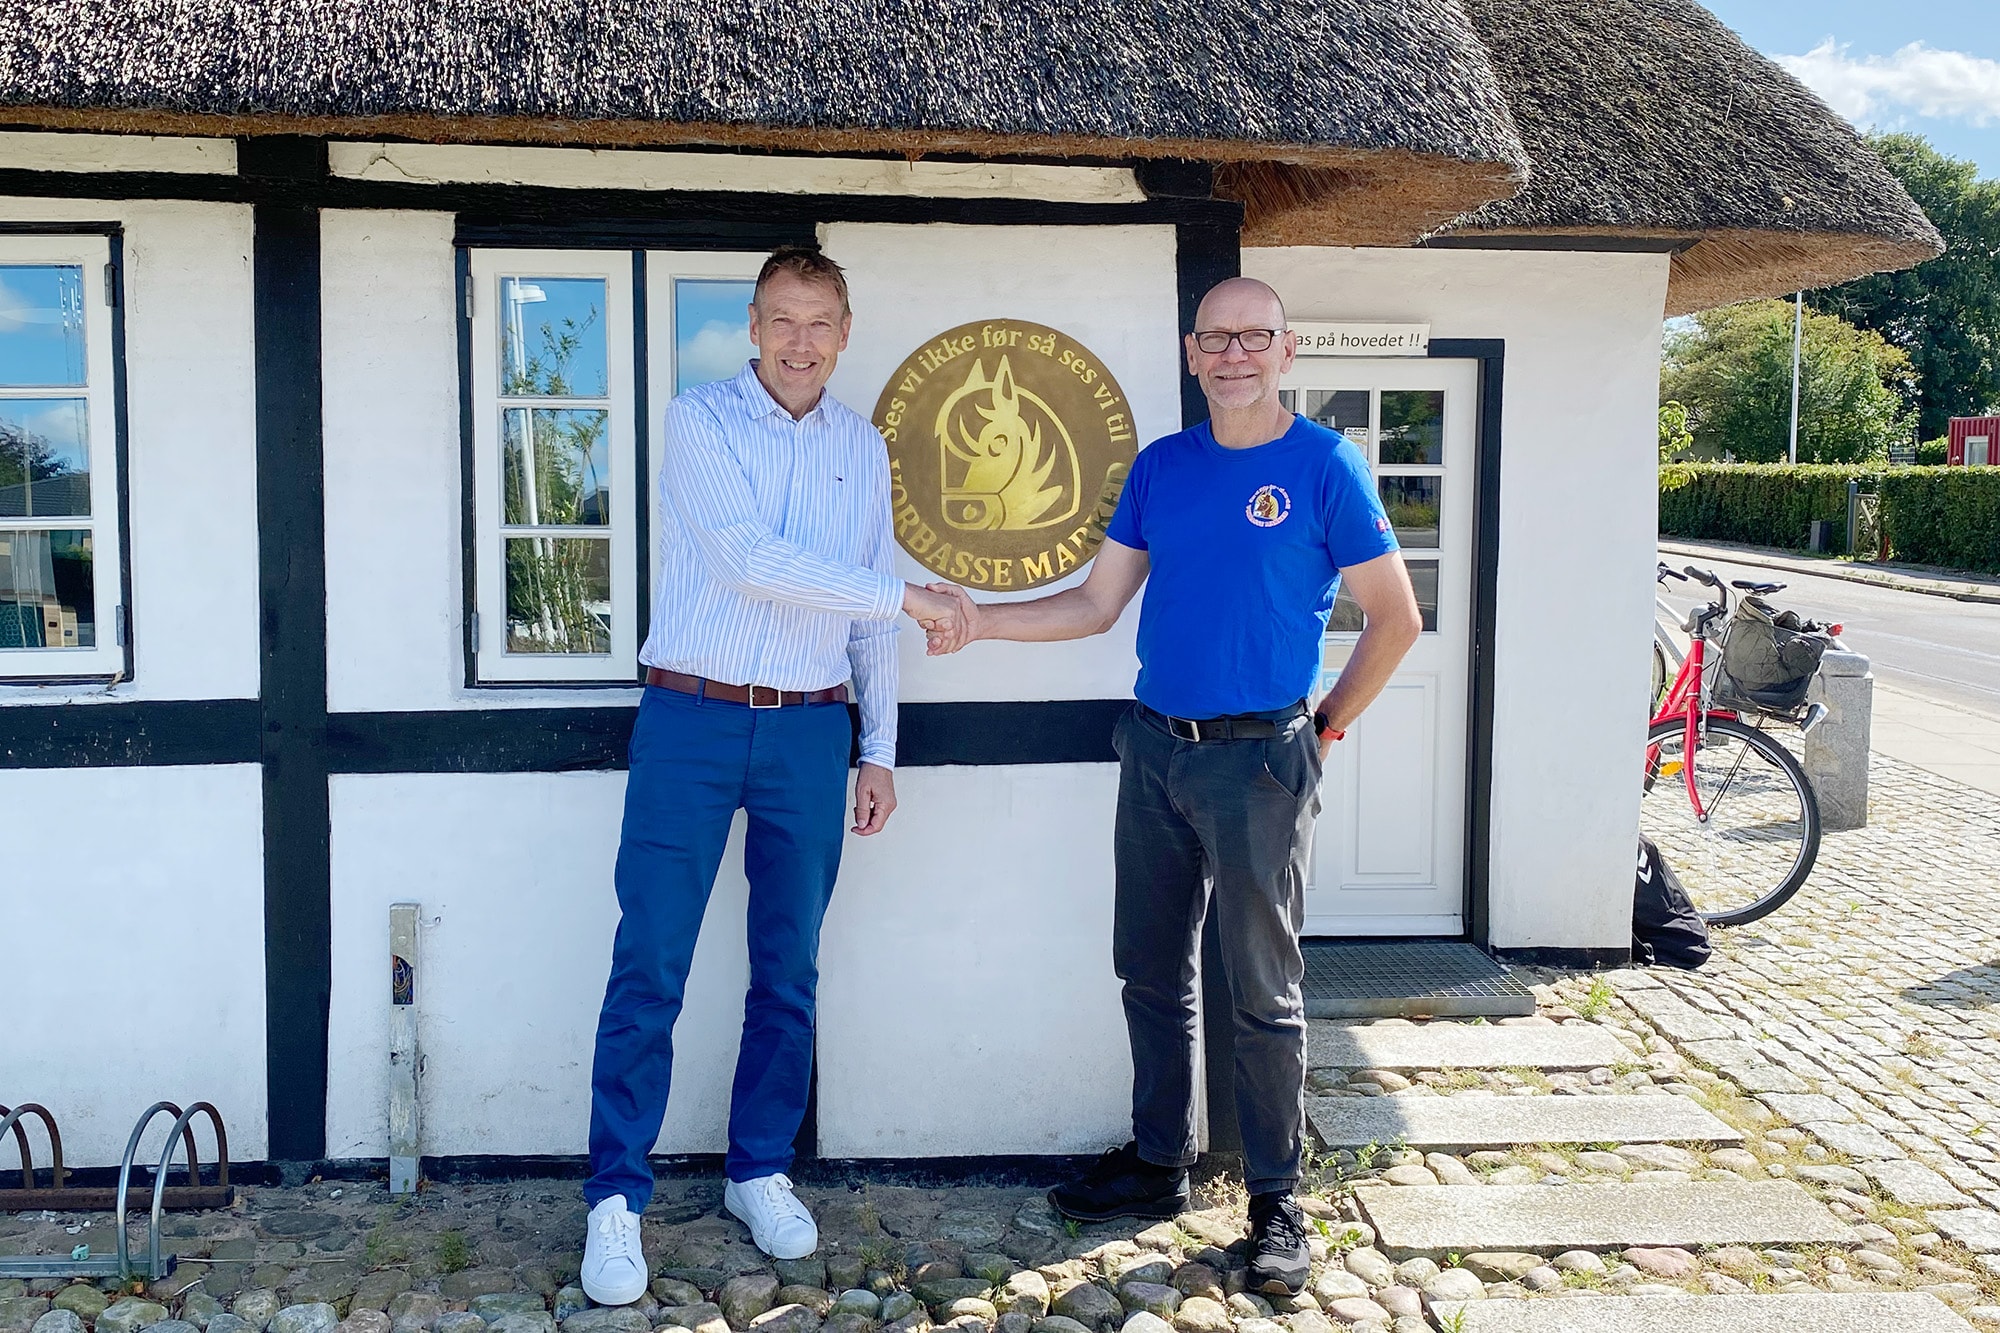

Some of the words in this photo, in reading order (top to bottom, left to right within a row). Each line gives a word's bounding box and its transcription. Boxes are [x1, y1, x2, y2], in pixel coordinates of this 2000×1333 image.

[981, 324, 1023, 348] før
[1027, 333, 1057, 357] så
[1296, 334, 1311, 346] as
[1316, 332, 1335, 349] på
[1340, 332, 1404, 348] hovedet
[918, 335, 977, 374] ikke
[1057, 349, 1098, 384] ses
[899, 367, 925, 394] vi
[1094, 382, 1120, 411] vi
[877, 397, 907, 442] Ses
[1106, 413, 1132, 443] til
[889, 457, 1014, 586] ORBASSE
